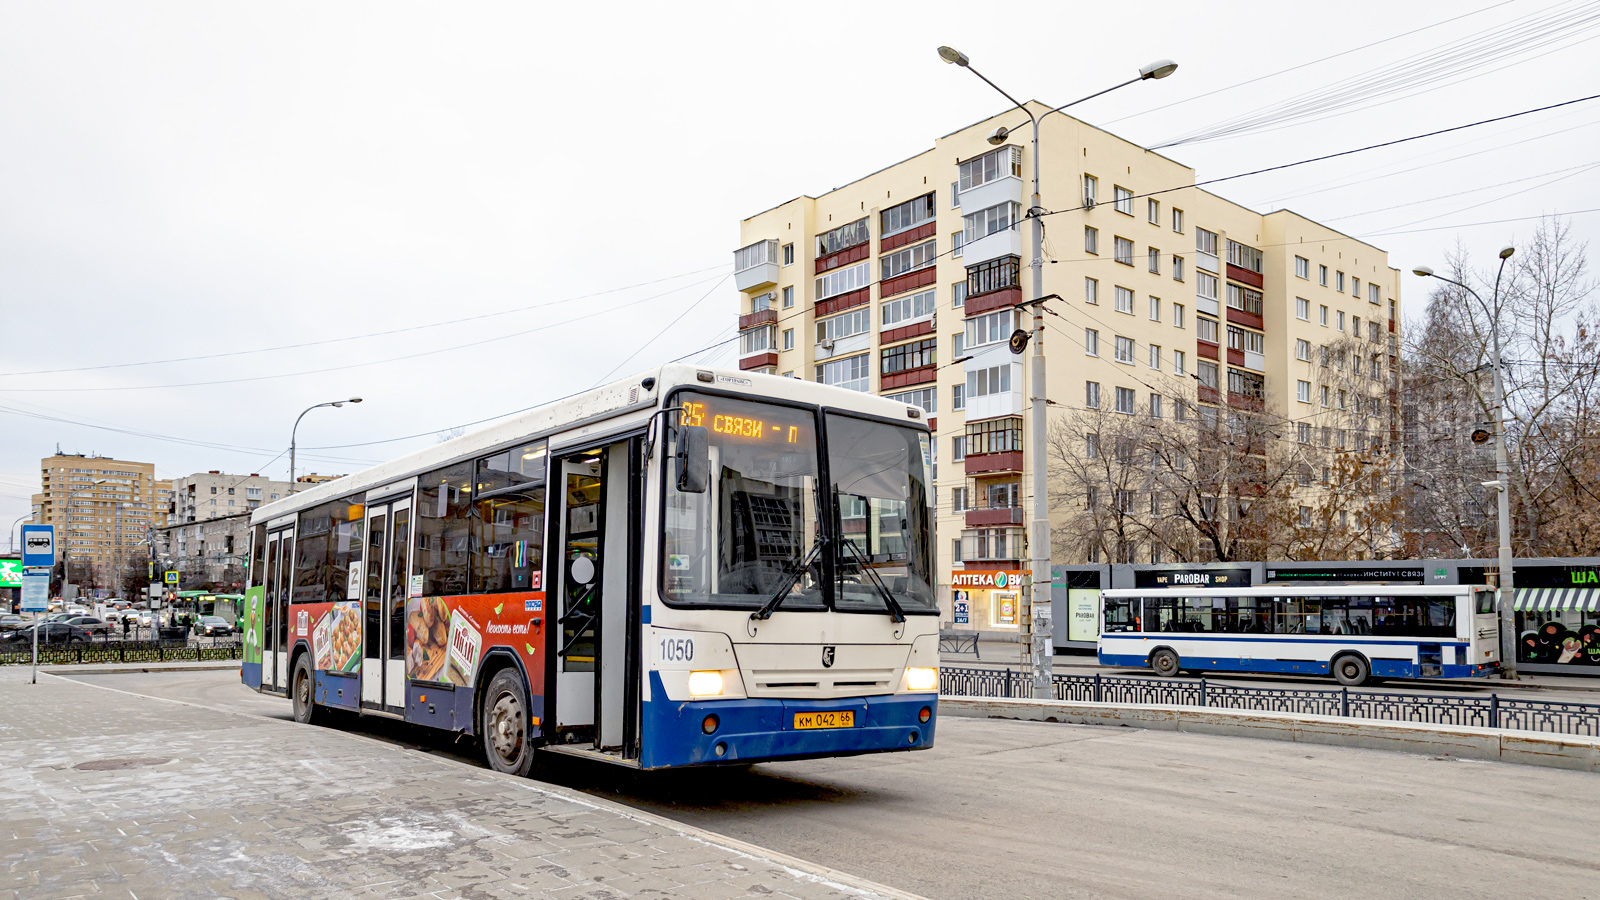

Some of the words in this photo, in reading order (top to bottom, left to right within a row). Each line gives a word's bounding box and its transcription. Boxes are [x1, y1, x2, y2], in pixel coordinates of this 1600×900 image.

[713, 414, 763, 438] СВЯЗИ
[788, 425, 798, 443] П
[351, 567, 359, 585] 2
[952, 574, 994, 585] АПТЕКА
[1214, 575, 1228, 583] SHOP
[1401, 570, 1425, 578] СВЯЗИ
[1571, 570, 1600, 583] ША
[955, 604, 968, 612] 2+1
[660, 638, 693, 661] 1050
[799, 716, 812, 727] КМ
[816, 713, 835, 726] 042
[840, 712, 850, 722] 66
